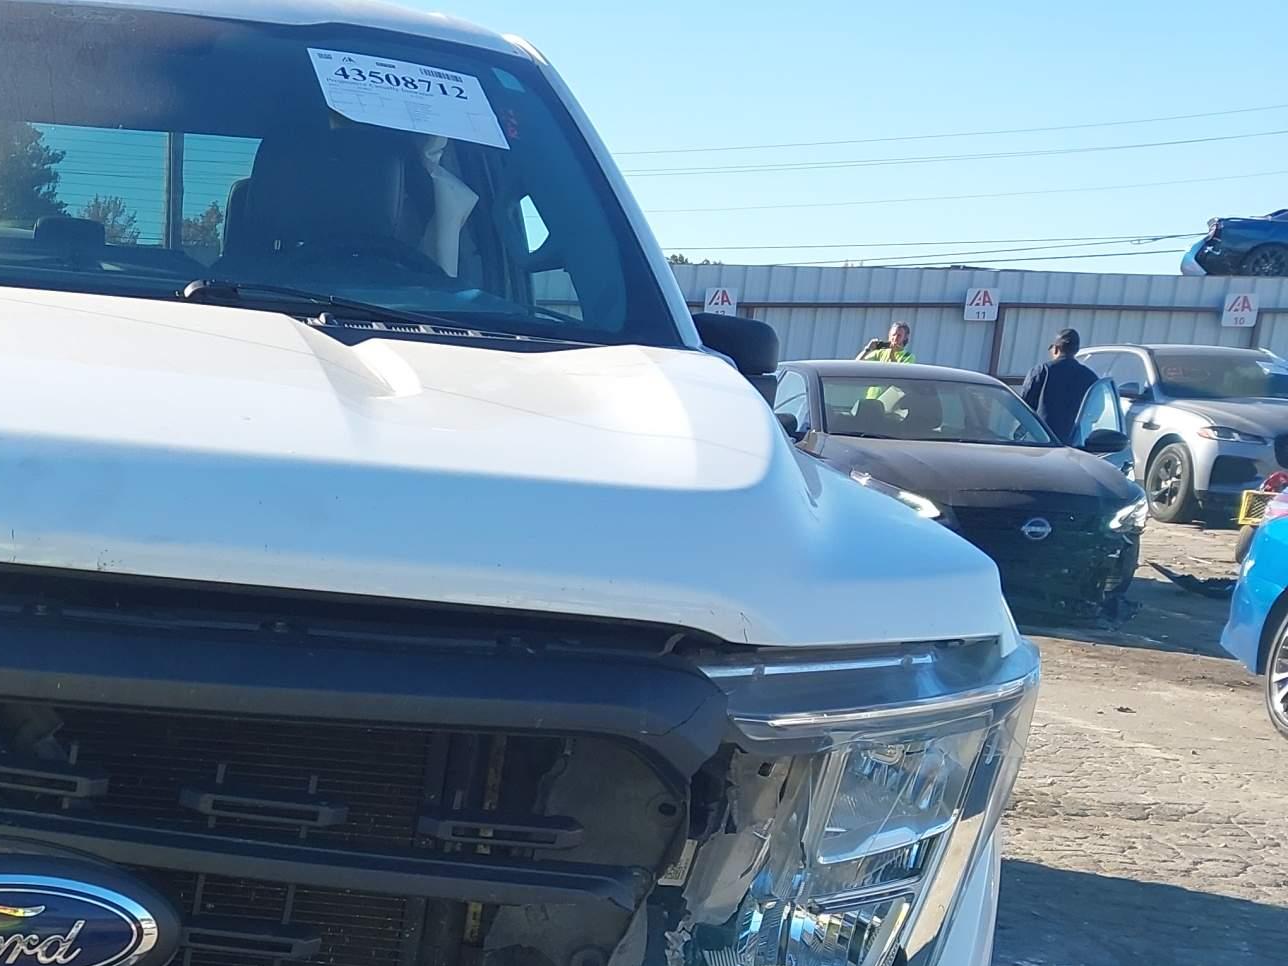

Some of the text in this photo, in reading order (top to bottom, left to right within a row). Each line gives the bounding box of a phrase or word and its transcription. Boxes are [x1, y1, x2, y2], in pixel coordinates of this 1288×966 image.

[334, 66, 468, 100] 43508712
[976, 311, 985, 319] 11
[1234, 317, 1244, 325] 10
